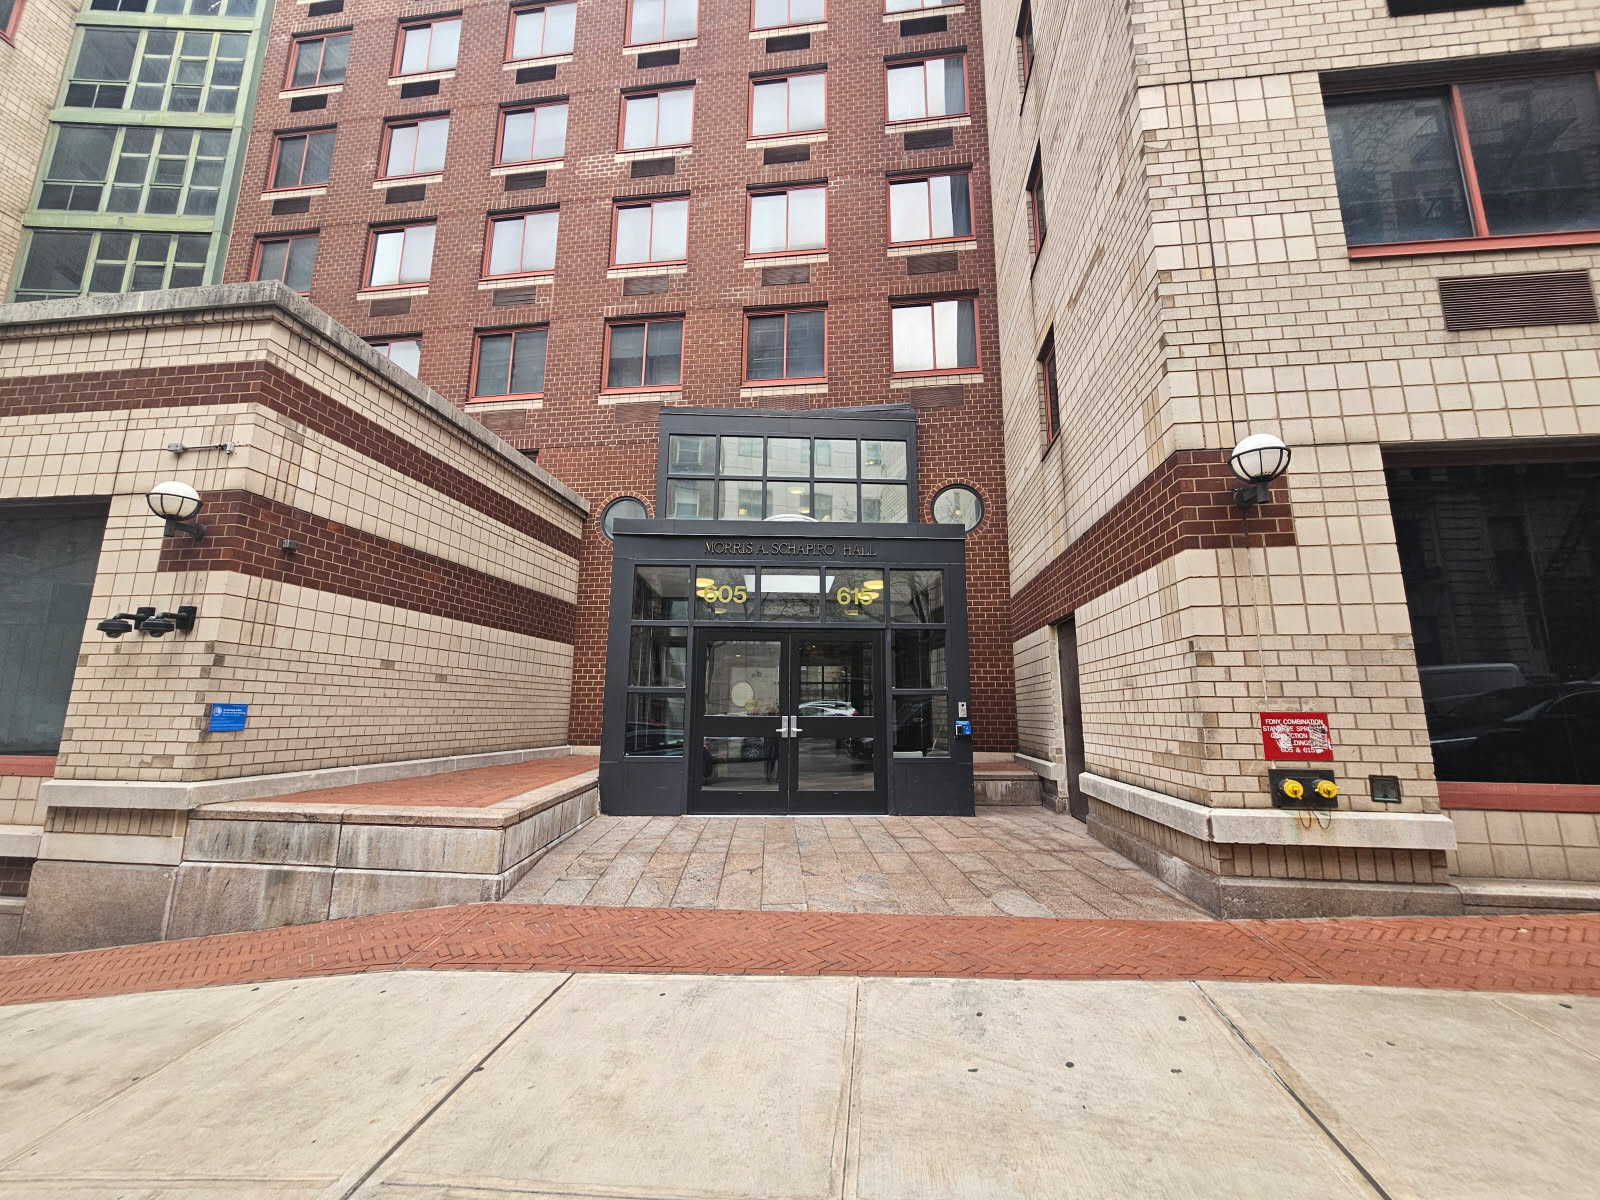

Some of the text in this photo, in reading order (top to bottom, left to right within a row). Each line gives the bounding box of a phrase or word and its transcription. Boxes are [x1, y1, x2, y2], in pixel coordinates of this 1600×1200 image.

[704, 541, 877, 557] MORRIS A. SCHAPIRO HALL
[703, 585, 747, 603] 605
[836, 587, 873, 605] 615
